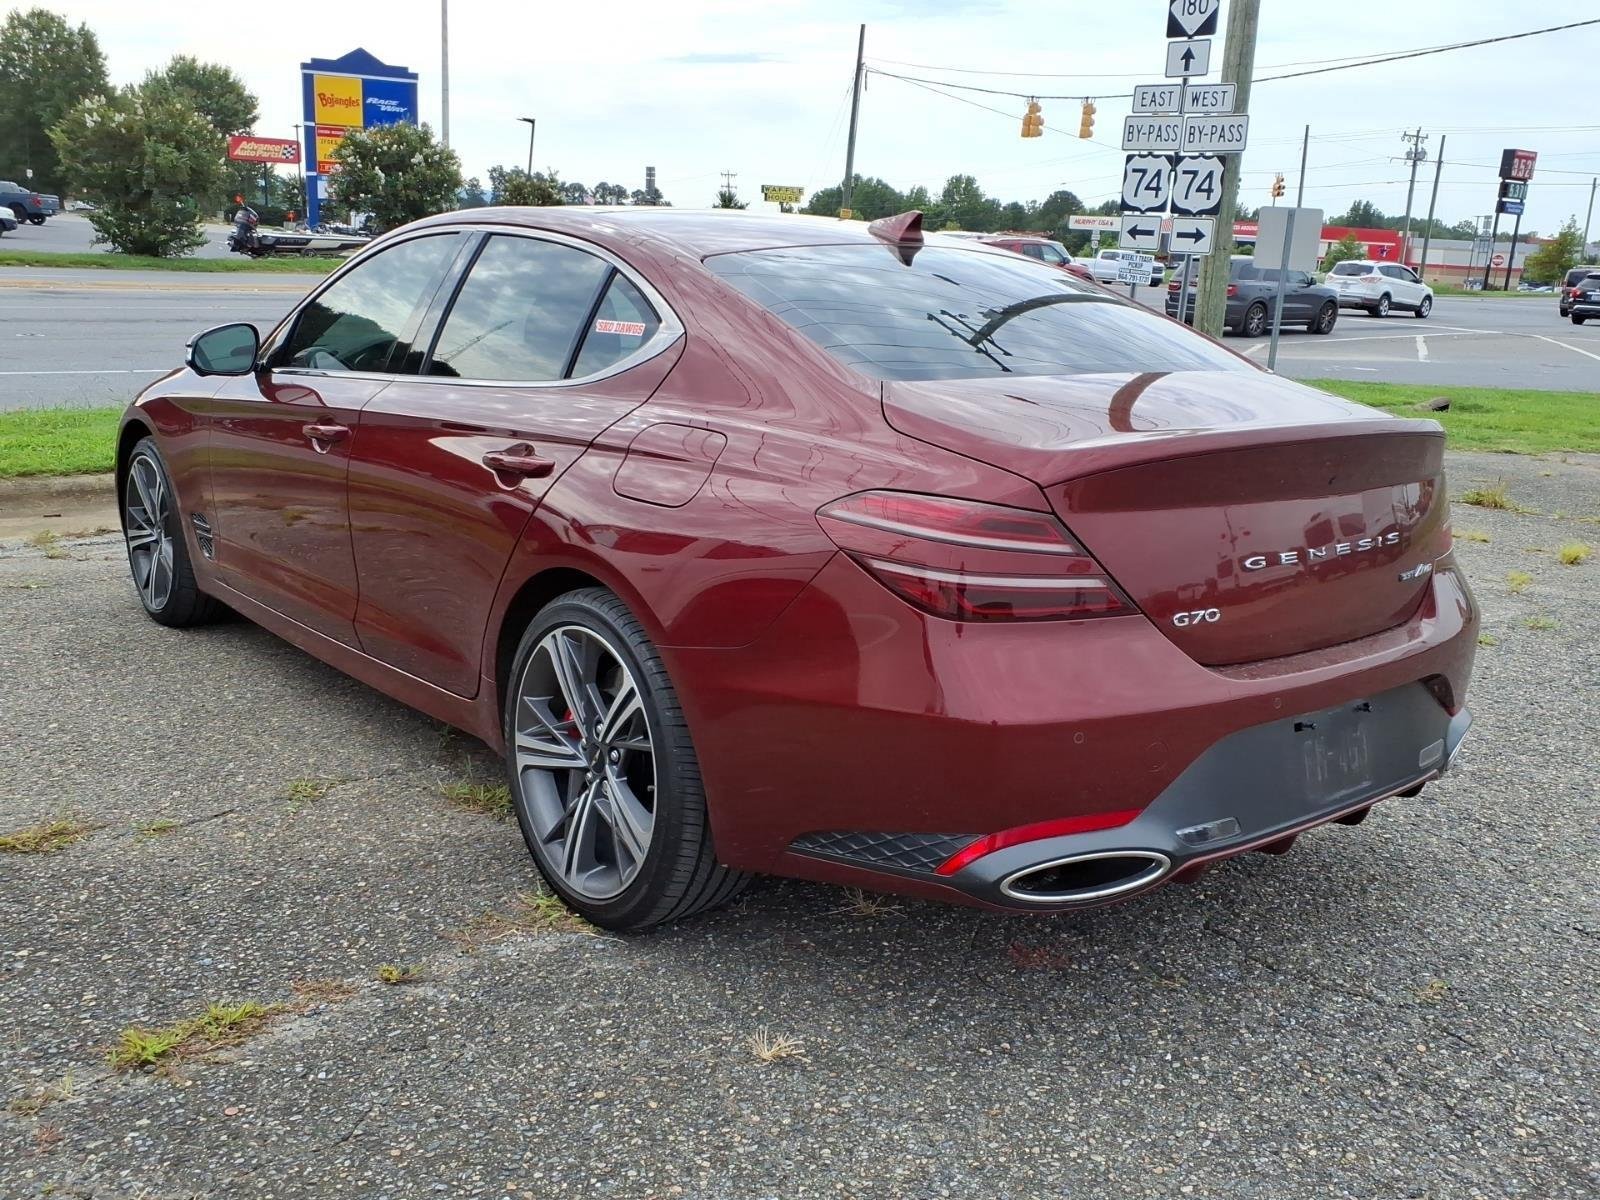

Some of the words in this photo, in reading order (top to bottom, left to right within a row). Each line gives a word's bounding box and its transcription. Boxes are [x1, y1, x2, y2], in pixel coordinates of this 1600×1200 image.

[1181, 0, 1209, 16] 180
[317, 92, 361, 108] Bojangles
[1140, 91, 1174, 107] EAST
[1191, 90, 1228, 107] WEST
[1127, 124, 1179, 142] BY-PASS
[1187, 124, 1244, 143] BY-PASS
[233, 149, 256, 157] Auto
[256, 150, 280, 158] Parts
[239, 141, 281, 151] Advance
[1132, 168, 1162, 198] 74
[1182, 170, 1214, 200] 74
[768, 194, 800, 202] HOUSE
[1244, 532, 1400, 569] GENESIS
[1172, 608, 1221, 627] G70
